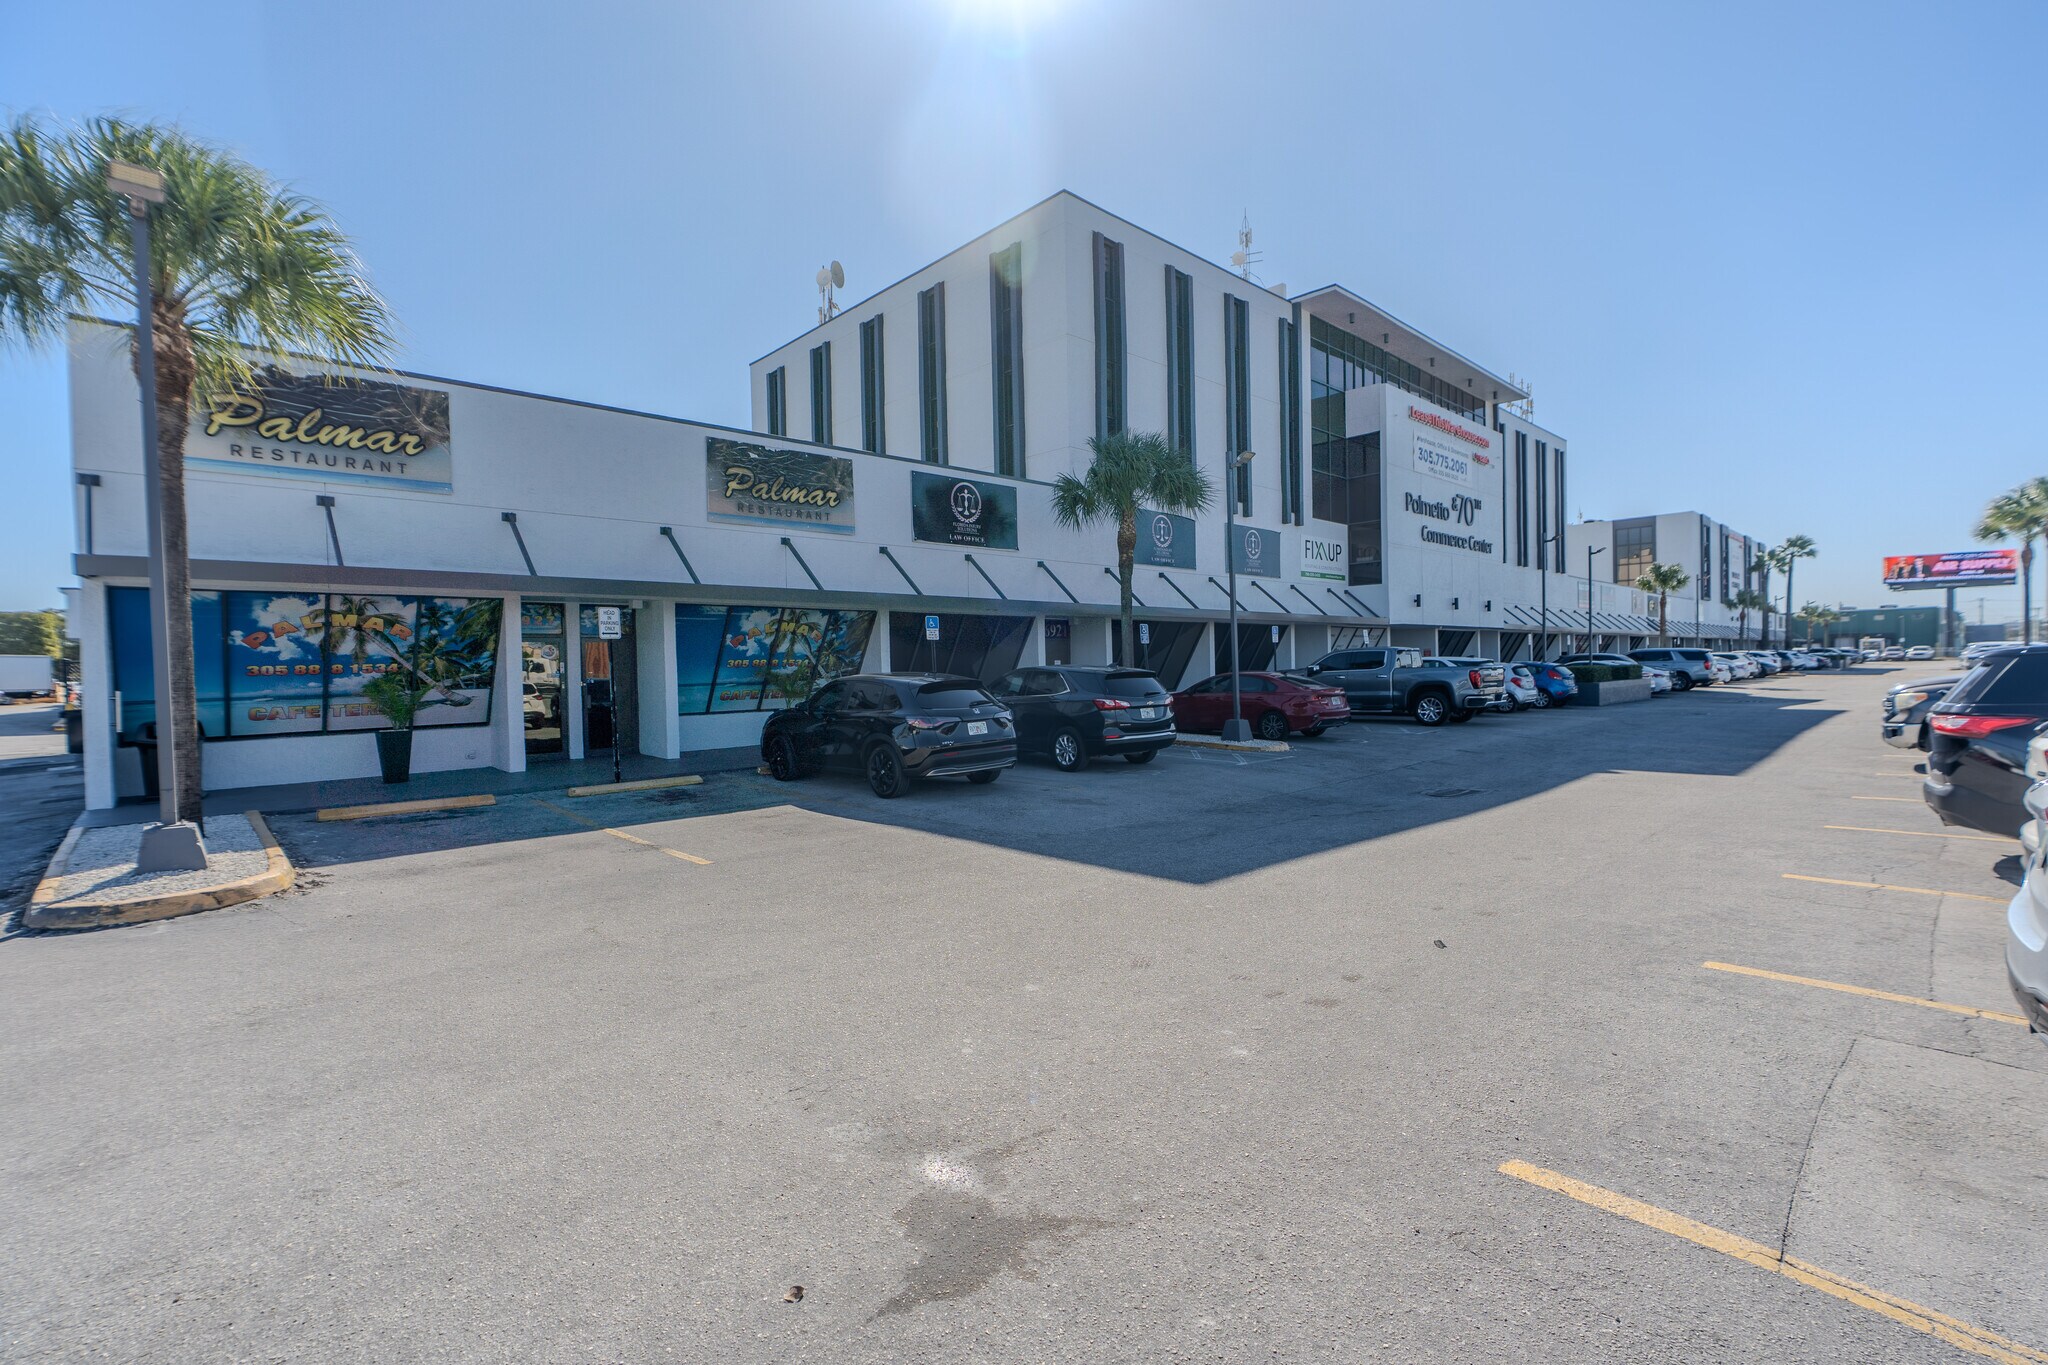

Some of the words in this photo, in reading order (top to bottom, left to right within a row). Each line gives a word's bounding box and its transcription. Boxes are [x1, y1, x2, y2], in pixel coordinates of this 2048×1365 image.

[204, 393, 426, 456] Palmar
[230, 443, 407, 474] RESTAURANT
[1418, 447, 1468, 476] 305.775.2061
[724, 466, 841, 508] Palmar
[737, 502, 831, 521] RESTAURANT
[1405, 492, 1450, 521] Palmetto
[963, 535, 985, 543] OFFICE
[1421, 525, 1467, 550] Commerce
[1468, 535, 1493, 554] Center
[240, 613, 413, 650] PALMAR
[729, 622, 822, 649] PALMAR
[245, 665, 289, 677] 305
[349, 662, 399, 674] 1534
[727, 659, 750, 669] 305
[719, 690, 759, 701] CAFE
[248, 704, 321, 721] CAFE
